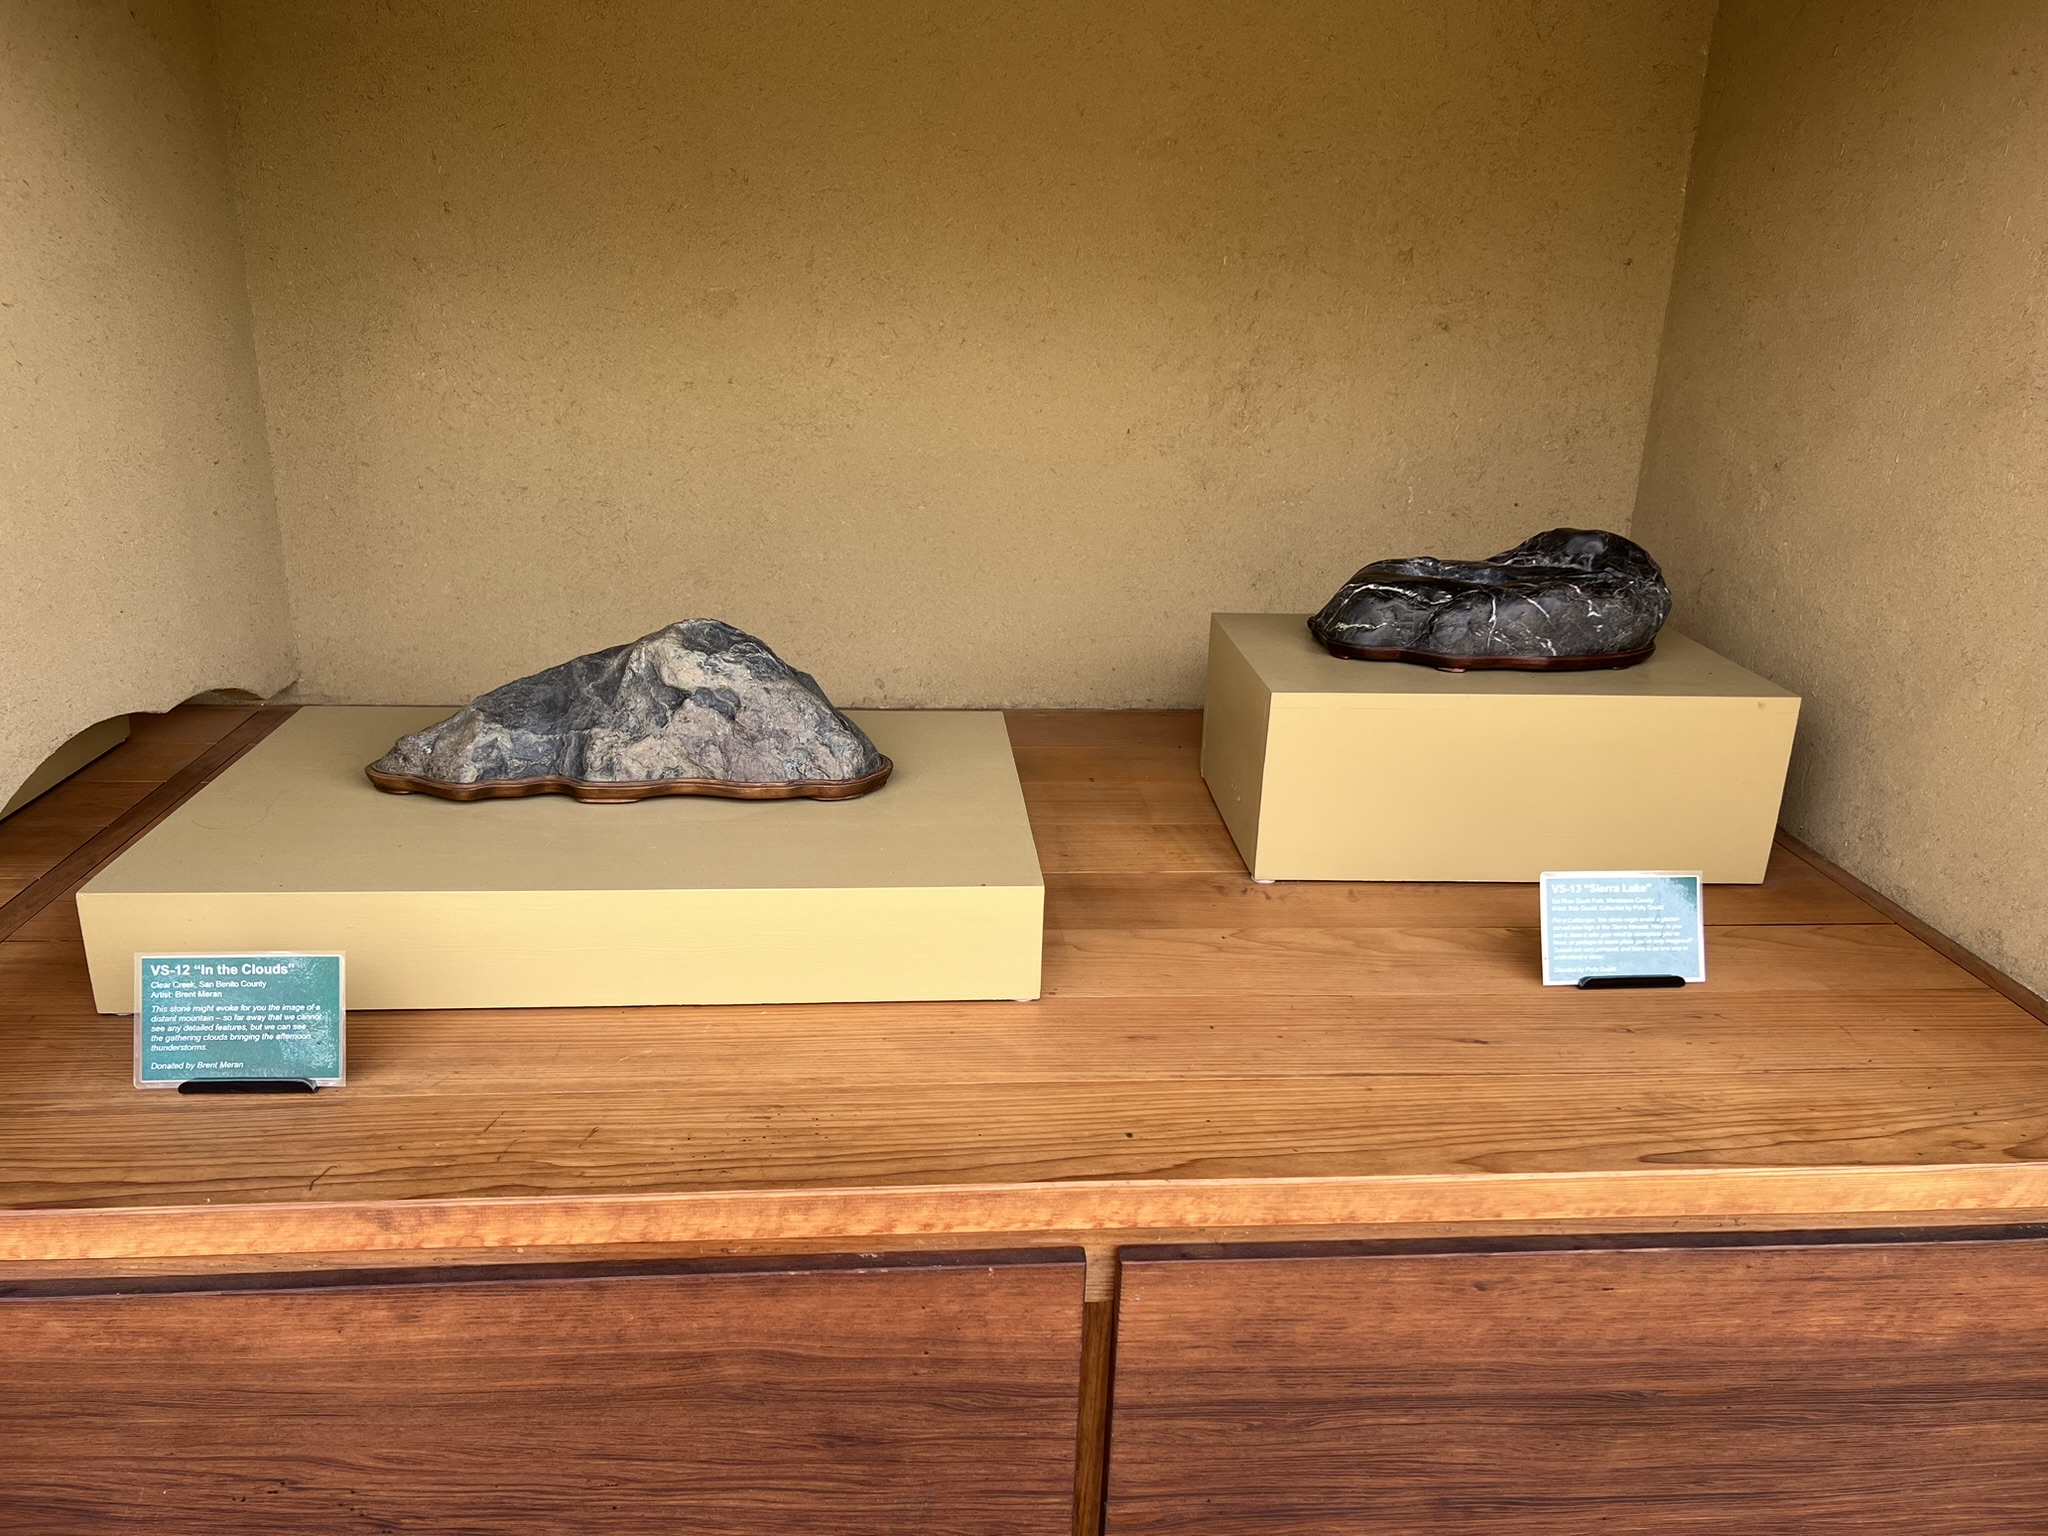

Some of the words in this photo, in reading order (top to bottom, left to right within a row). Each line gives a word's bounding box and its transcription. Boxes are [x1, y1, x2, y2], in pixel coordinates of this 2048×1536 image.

[1551, 884, 1582, 894] VS-13
[150, 964, 190, 976] VS-12
[194, 964, 214, 975] “In
[216, 964, 238, 975] the
[241, 963, 295, 975] Clouds”
[151, 981, 171, 989] Clear
[172, 981, 197, 989] Creek,
[215, 980, 240, 988] Benito
[240, 980, 267, 989] County
[150, 990, 173, 999] Artist:
[197, 990, 222, 998] Meran
[151, 1005, 168, 1013] This
[192, 1005, 214, 1013] might
[252, 1005, 267, 1013] you
[282, 1004, 305, 1012] image
[306, 1003, 315, 1011] of
[150, 1015, 177, 1023] distant
[267, 1013, 282, 1021] that
[296, 1013, 322, 1021] cannot
[167, 1025, 182, 1033] any
[183, 1024, 214, 1032] detailed
[215, 1024, 248, 1032] features,
[250, 1023, 263, 1031] but
[165, 1034, 201, 1043] gathering
[229, 1033, 260, 1042] bringing
[150, 1044, 208, 1052] thunderstorms.
[151, 1062, 184, 1070] Donated
[185, 1062, 196, 1071] by
[196, 1061, 218, 1069] Brent
[219, 1061, 243, 1069] Meran
